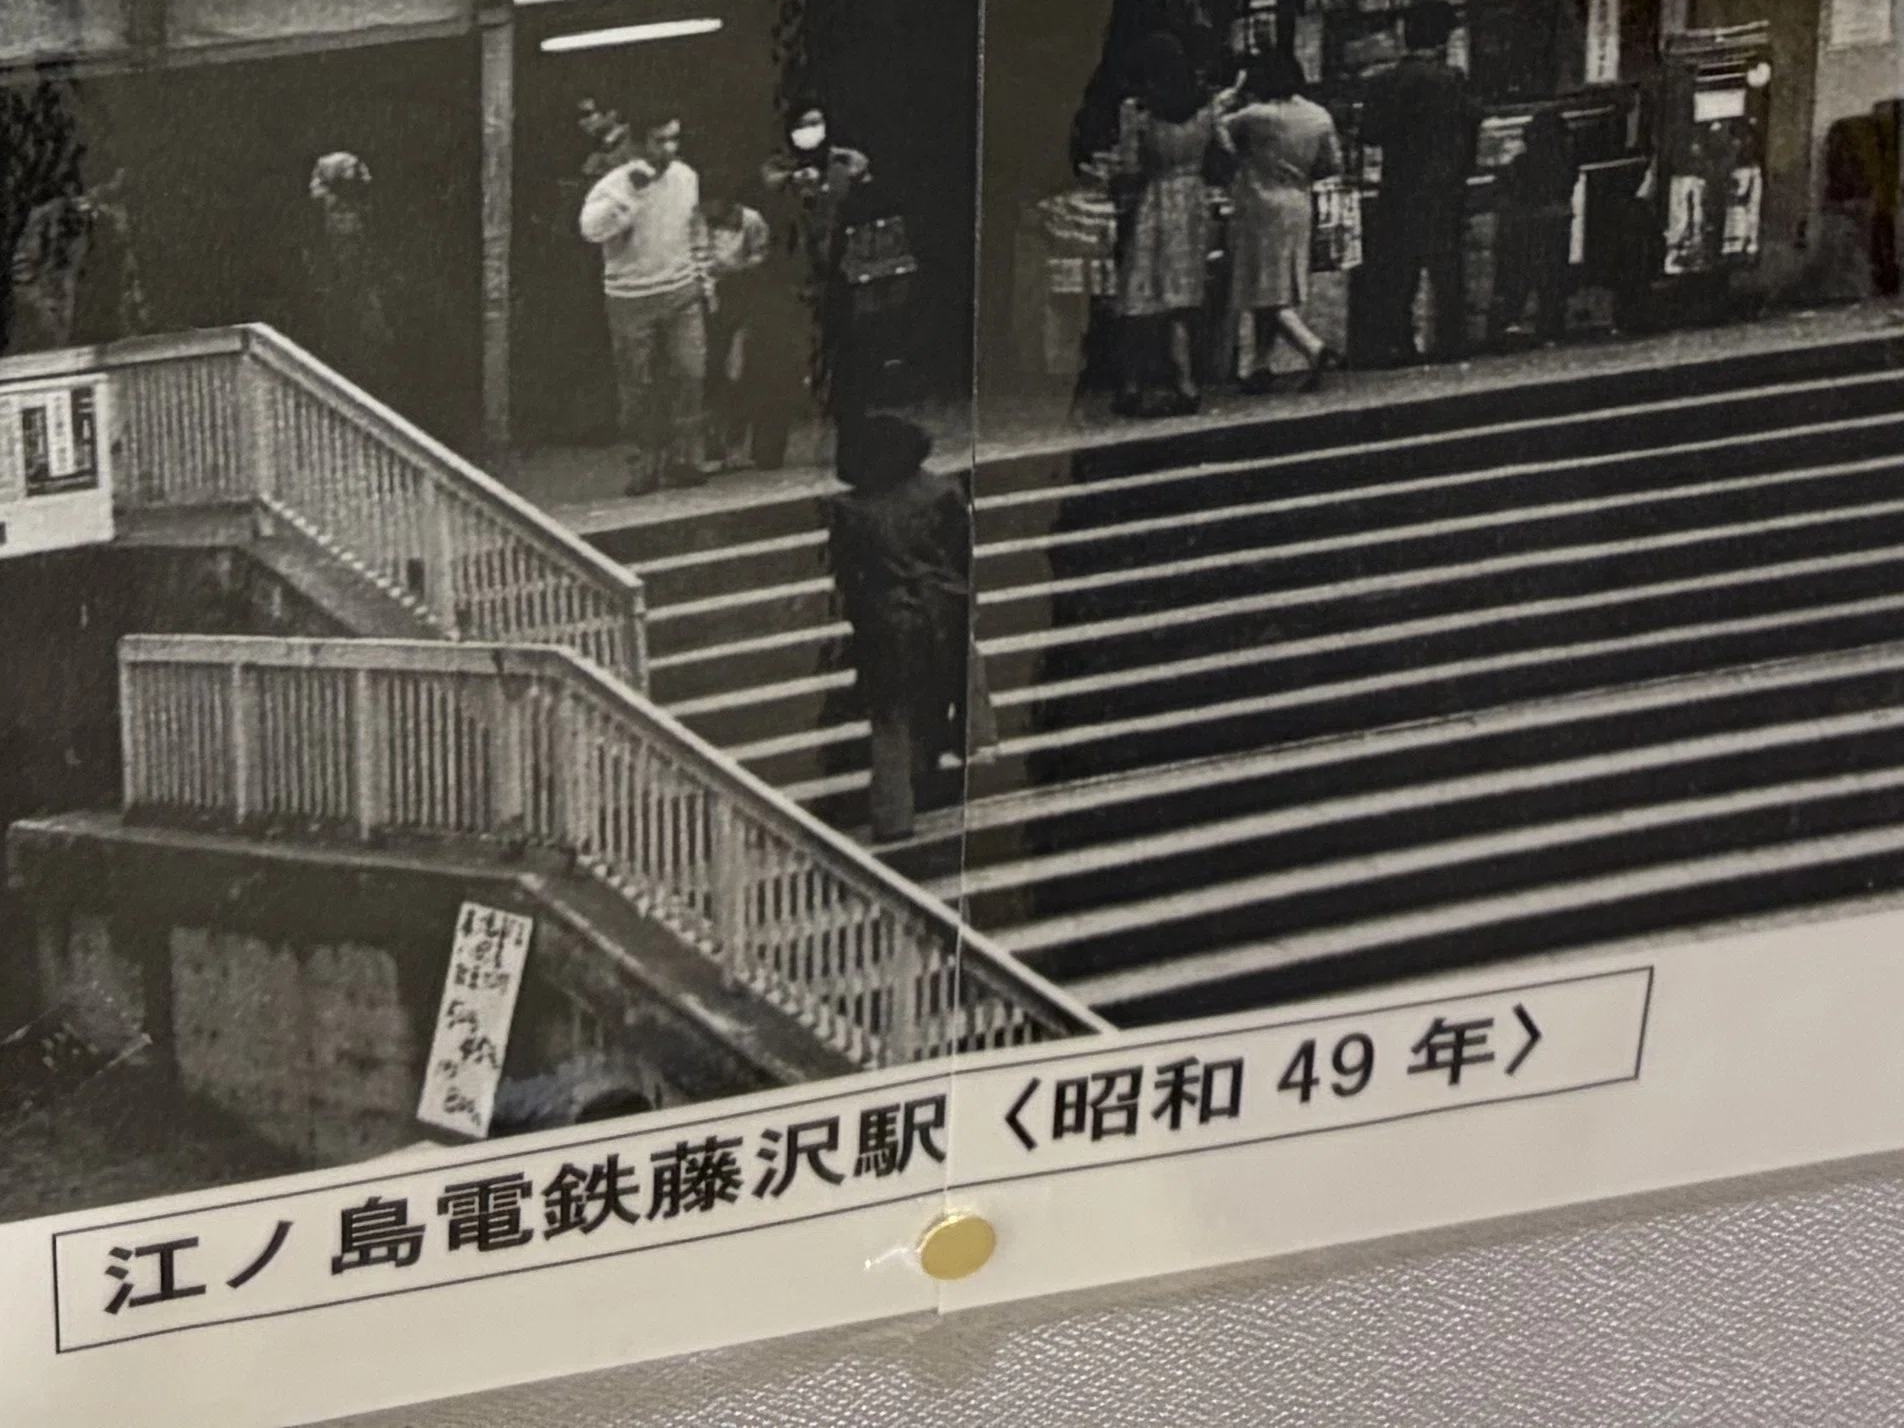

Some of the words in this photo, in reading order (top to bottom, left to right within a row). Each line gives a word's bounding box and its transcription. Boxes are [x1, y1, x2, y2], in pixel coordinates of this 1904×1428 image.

[103, 1093, 948, 1315] 江ノ島電鉄藤沢駅
